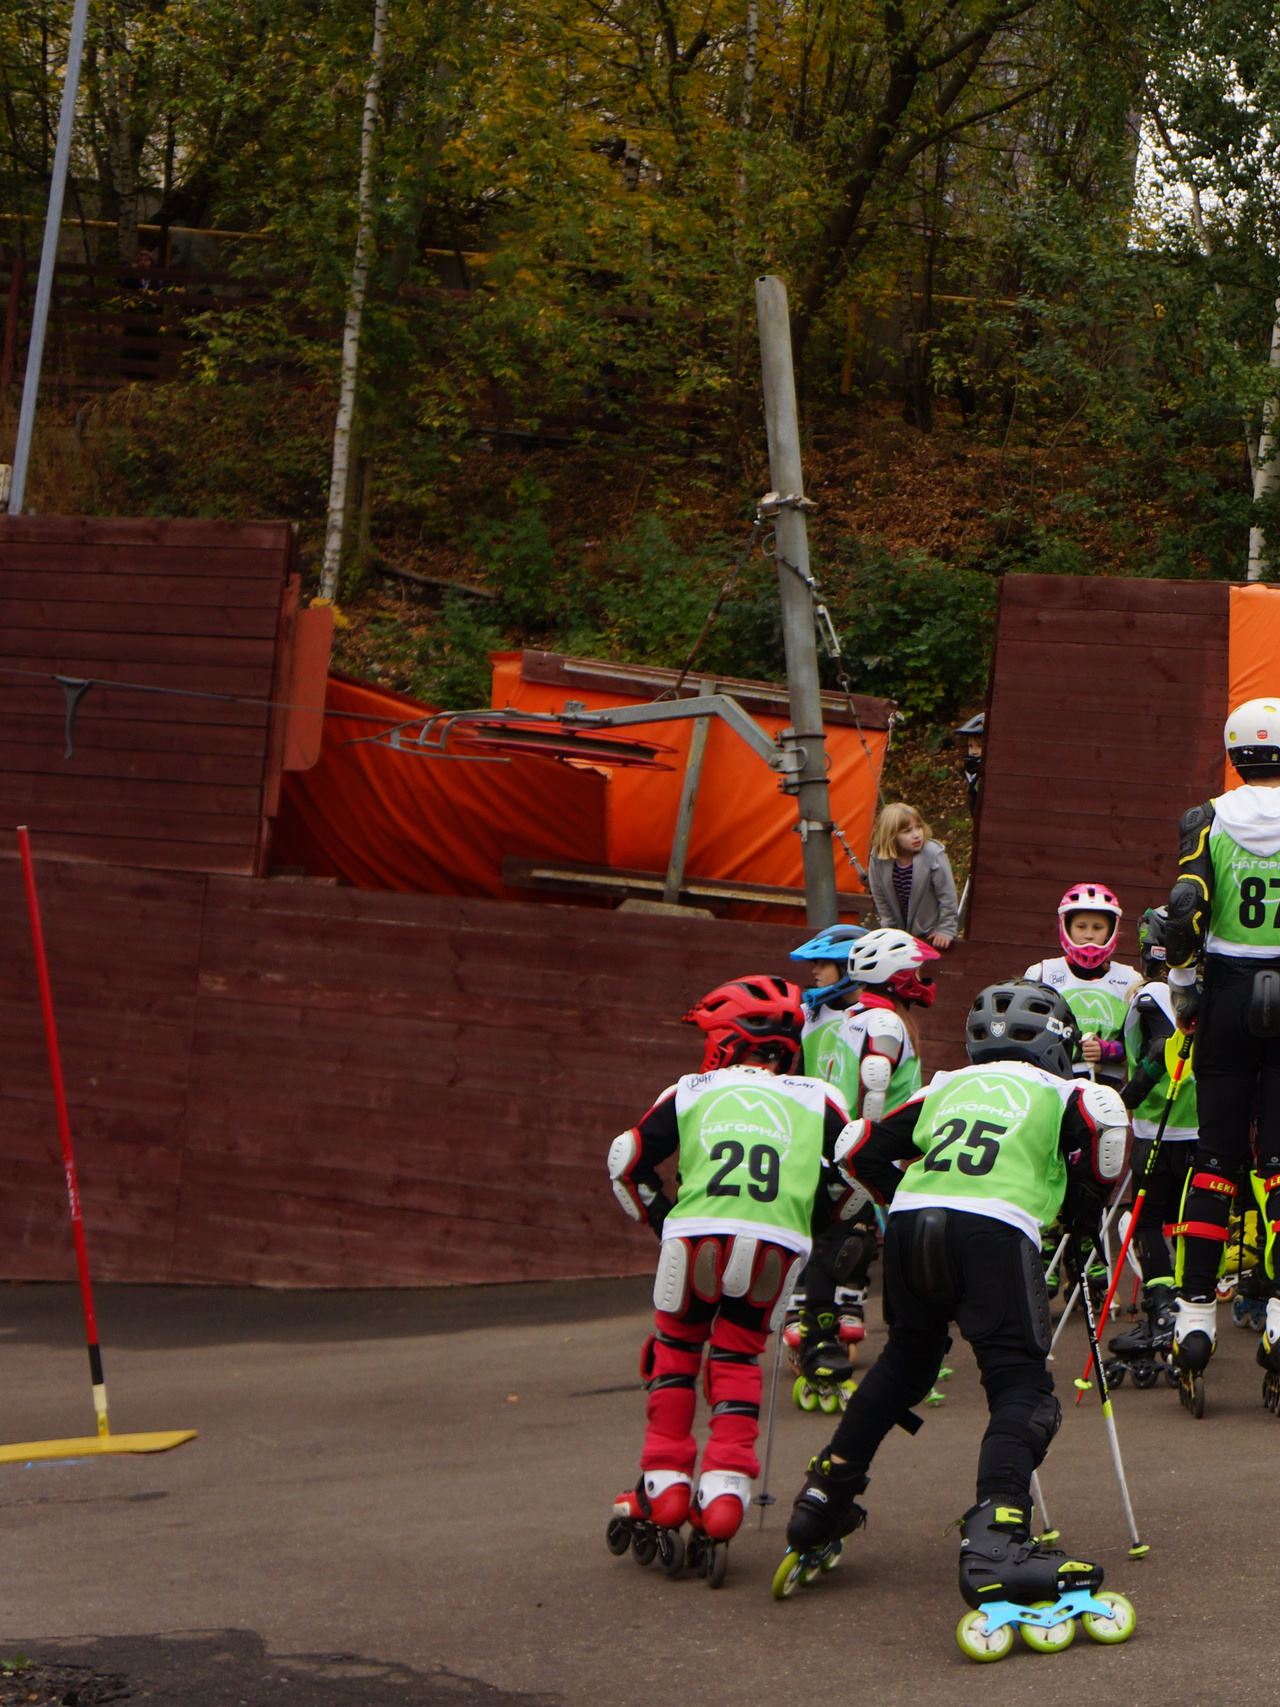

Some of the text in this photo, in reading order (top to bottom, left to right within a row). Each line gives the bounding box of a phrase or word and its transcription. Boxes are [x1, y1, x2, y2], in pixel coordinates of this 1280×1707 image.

[935, 1103, 1028, 1119] НАГОРНАЯ
[700, 1123, 791, 1144] НАГОРНАЯ
[923, 1118, 1009, 1176] 25
[706, 1140, 780, 1203] 29
[1209, 1181, 1235, 1194] LEKI
[1172, 1224, 1190, 1234] LEKI
